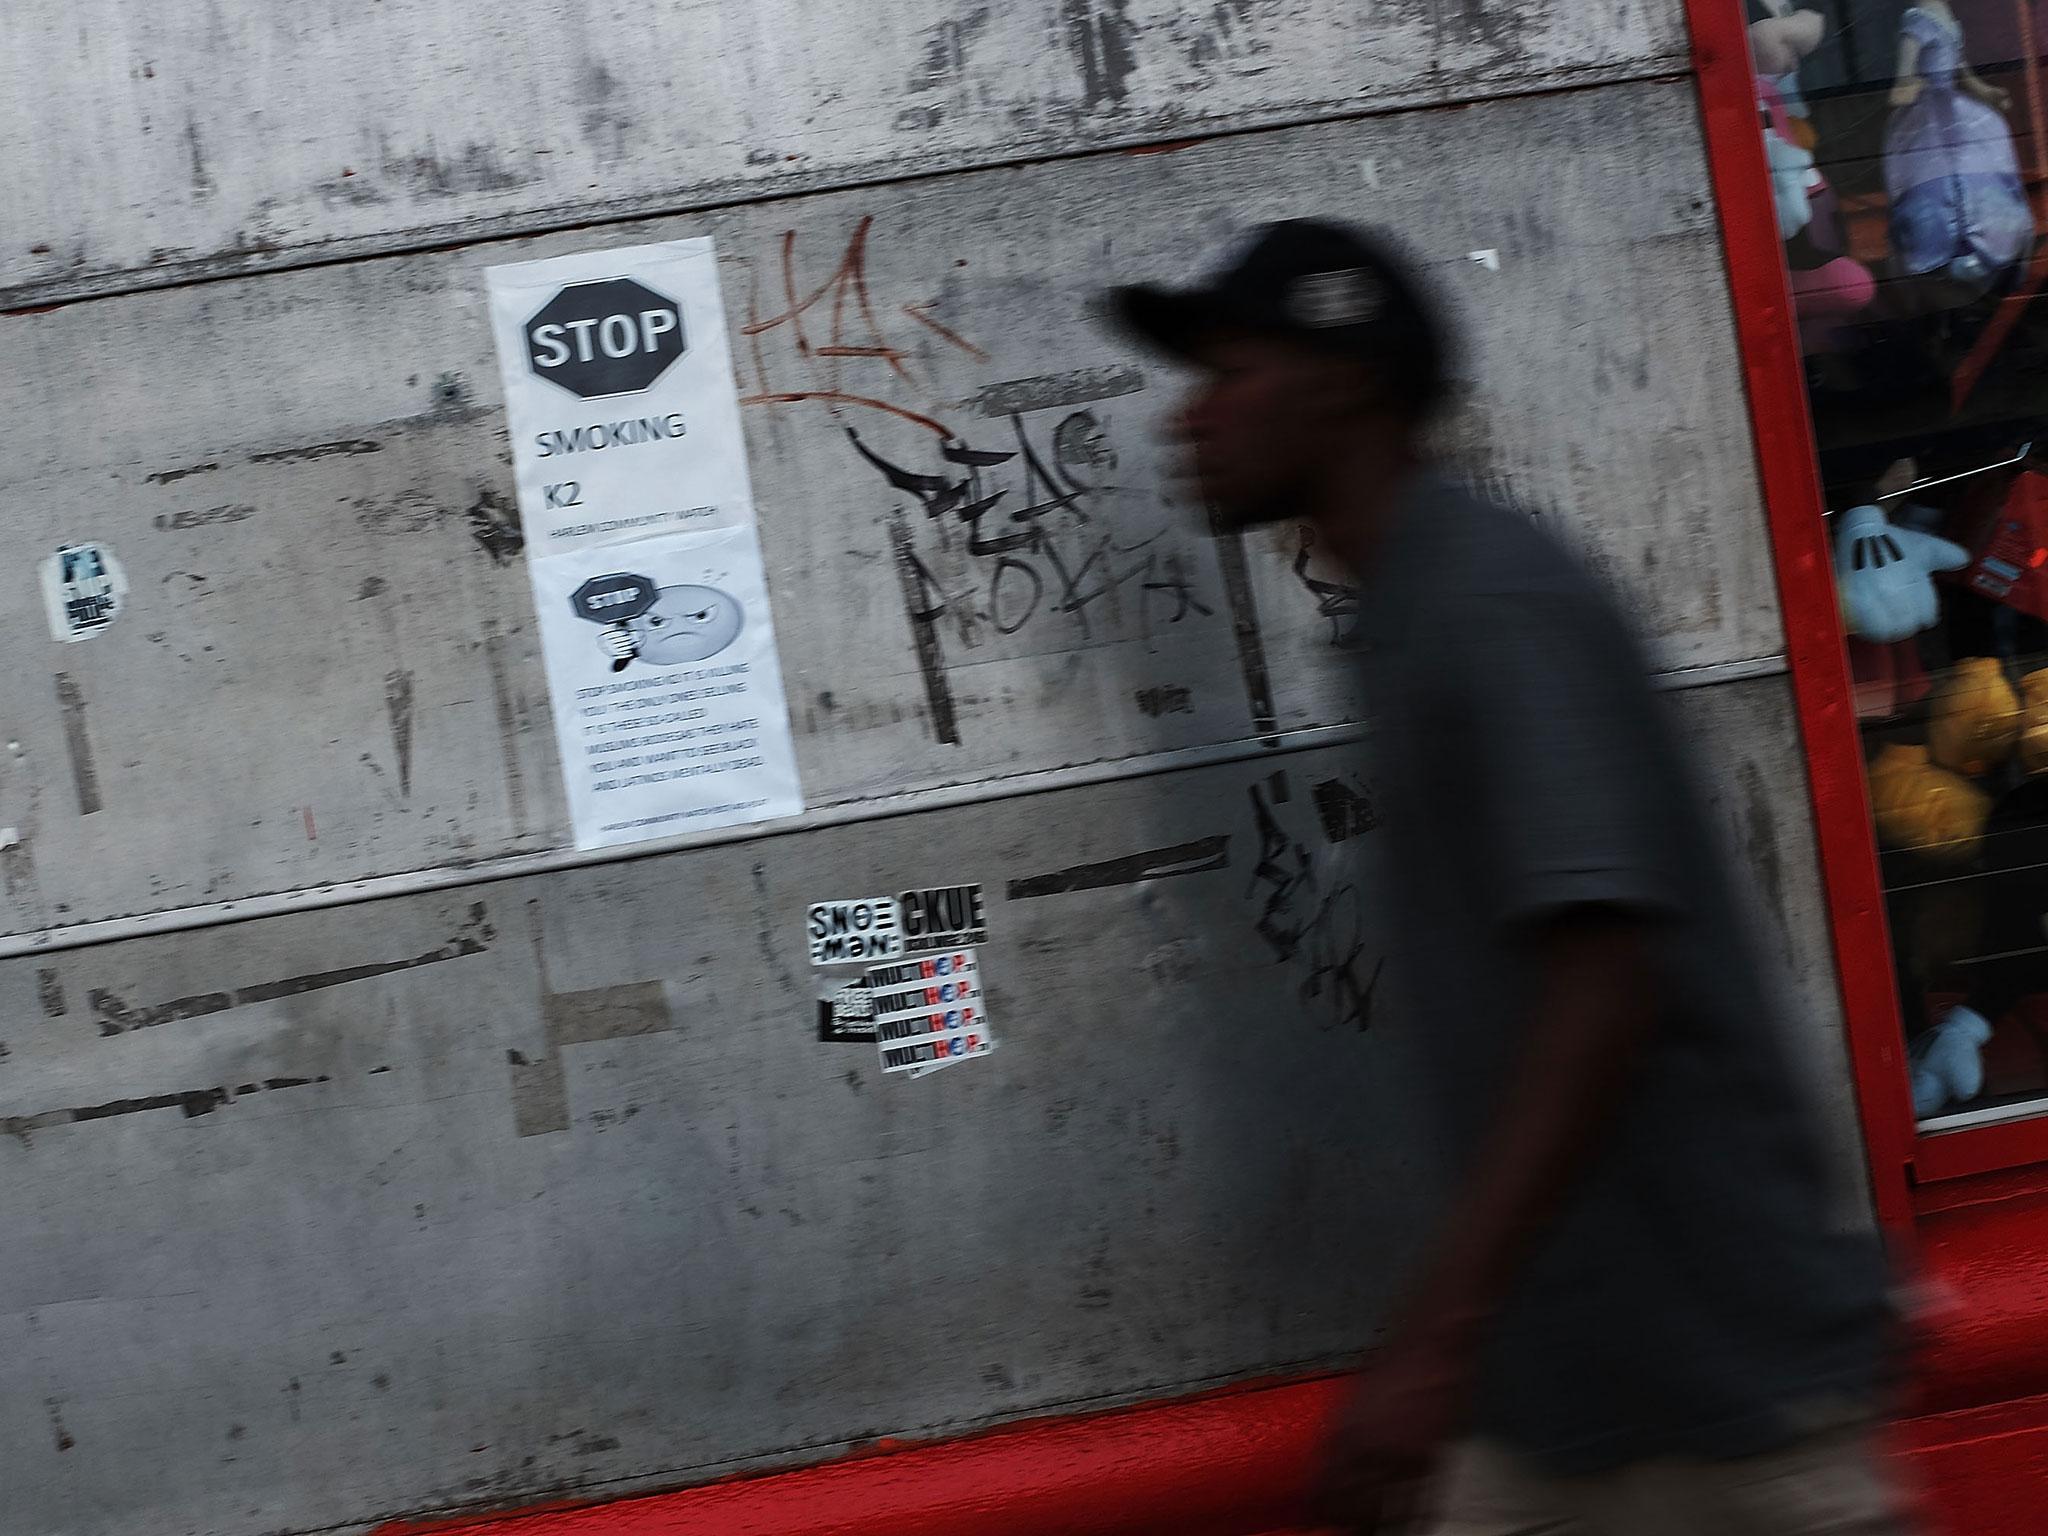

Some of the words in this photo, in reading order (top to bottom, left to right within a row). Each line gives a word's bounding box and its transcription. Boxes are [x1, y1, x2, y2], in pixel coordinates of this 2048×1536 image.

[532, 308, 679, 368] STOP
[535, 413, 687, 458] SMOKING
[543, 481, 583, 510] K2
